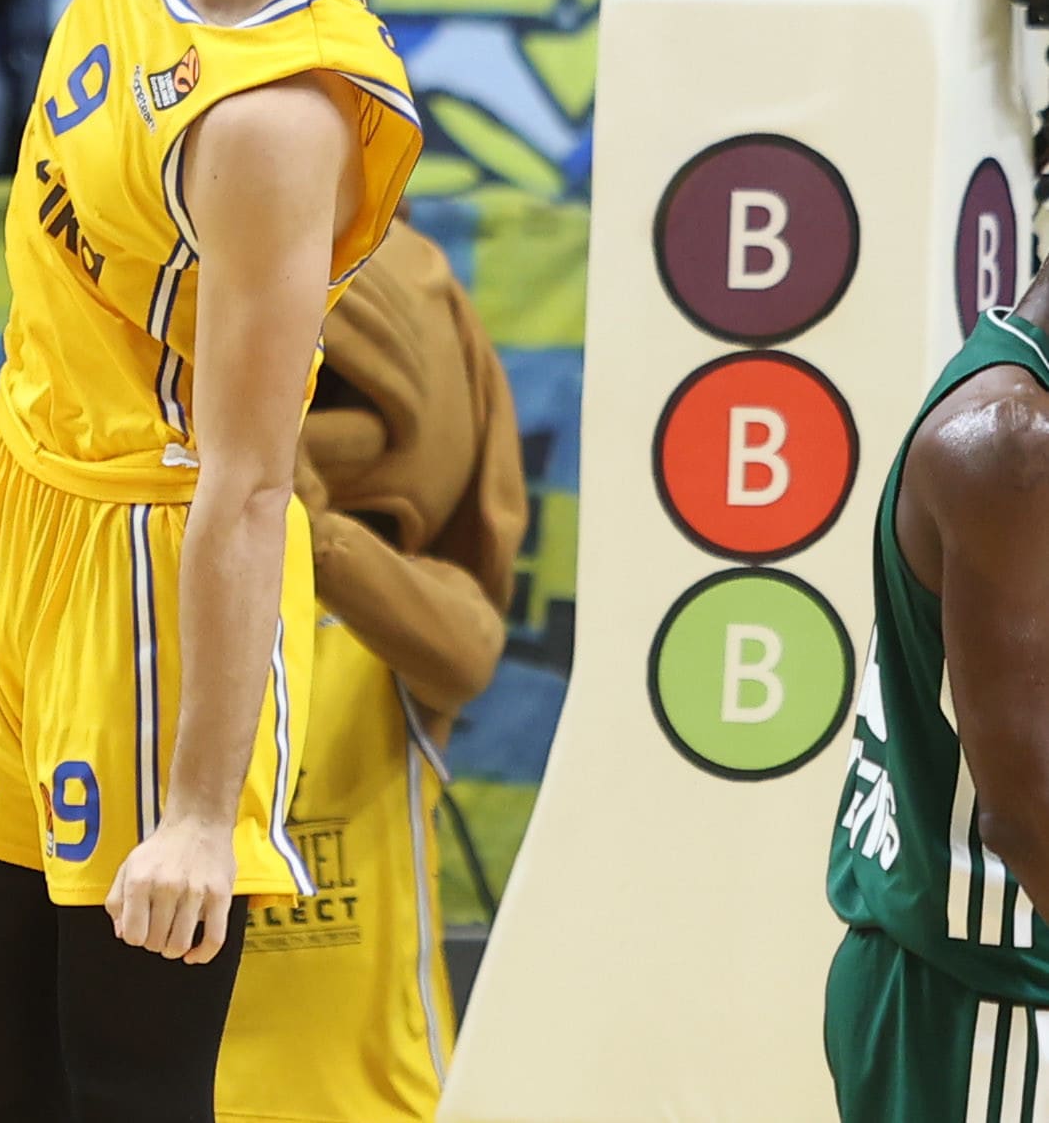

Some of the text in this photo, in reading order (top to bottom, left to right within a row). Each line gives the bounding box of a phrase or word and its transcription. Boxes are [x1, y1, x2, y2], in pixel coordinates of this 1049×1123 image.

[44, 43, 111, 137] 9
[726, 188, 792, 291] B
[977, 212, 1000, 312] B
[725, 405, 791, 507] B
[720, 622, 785, 725] B
[52, 760, 101, 863] 9
